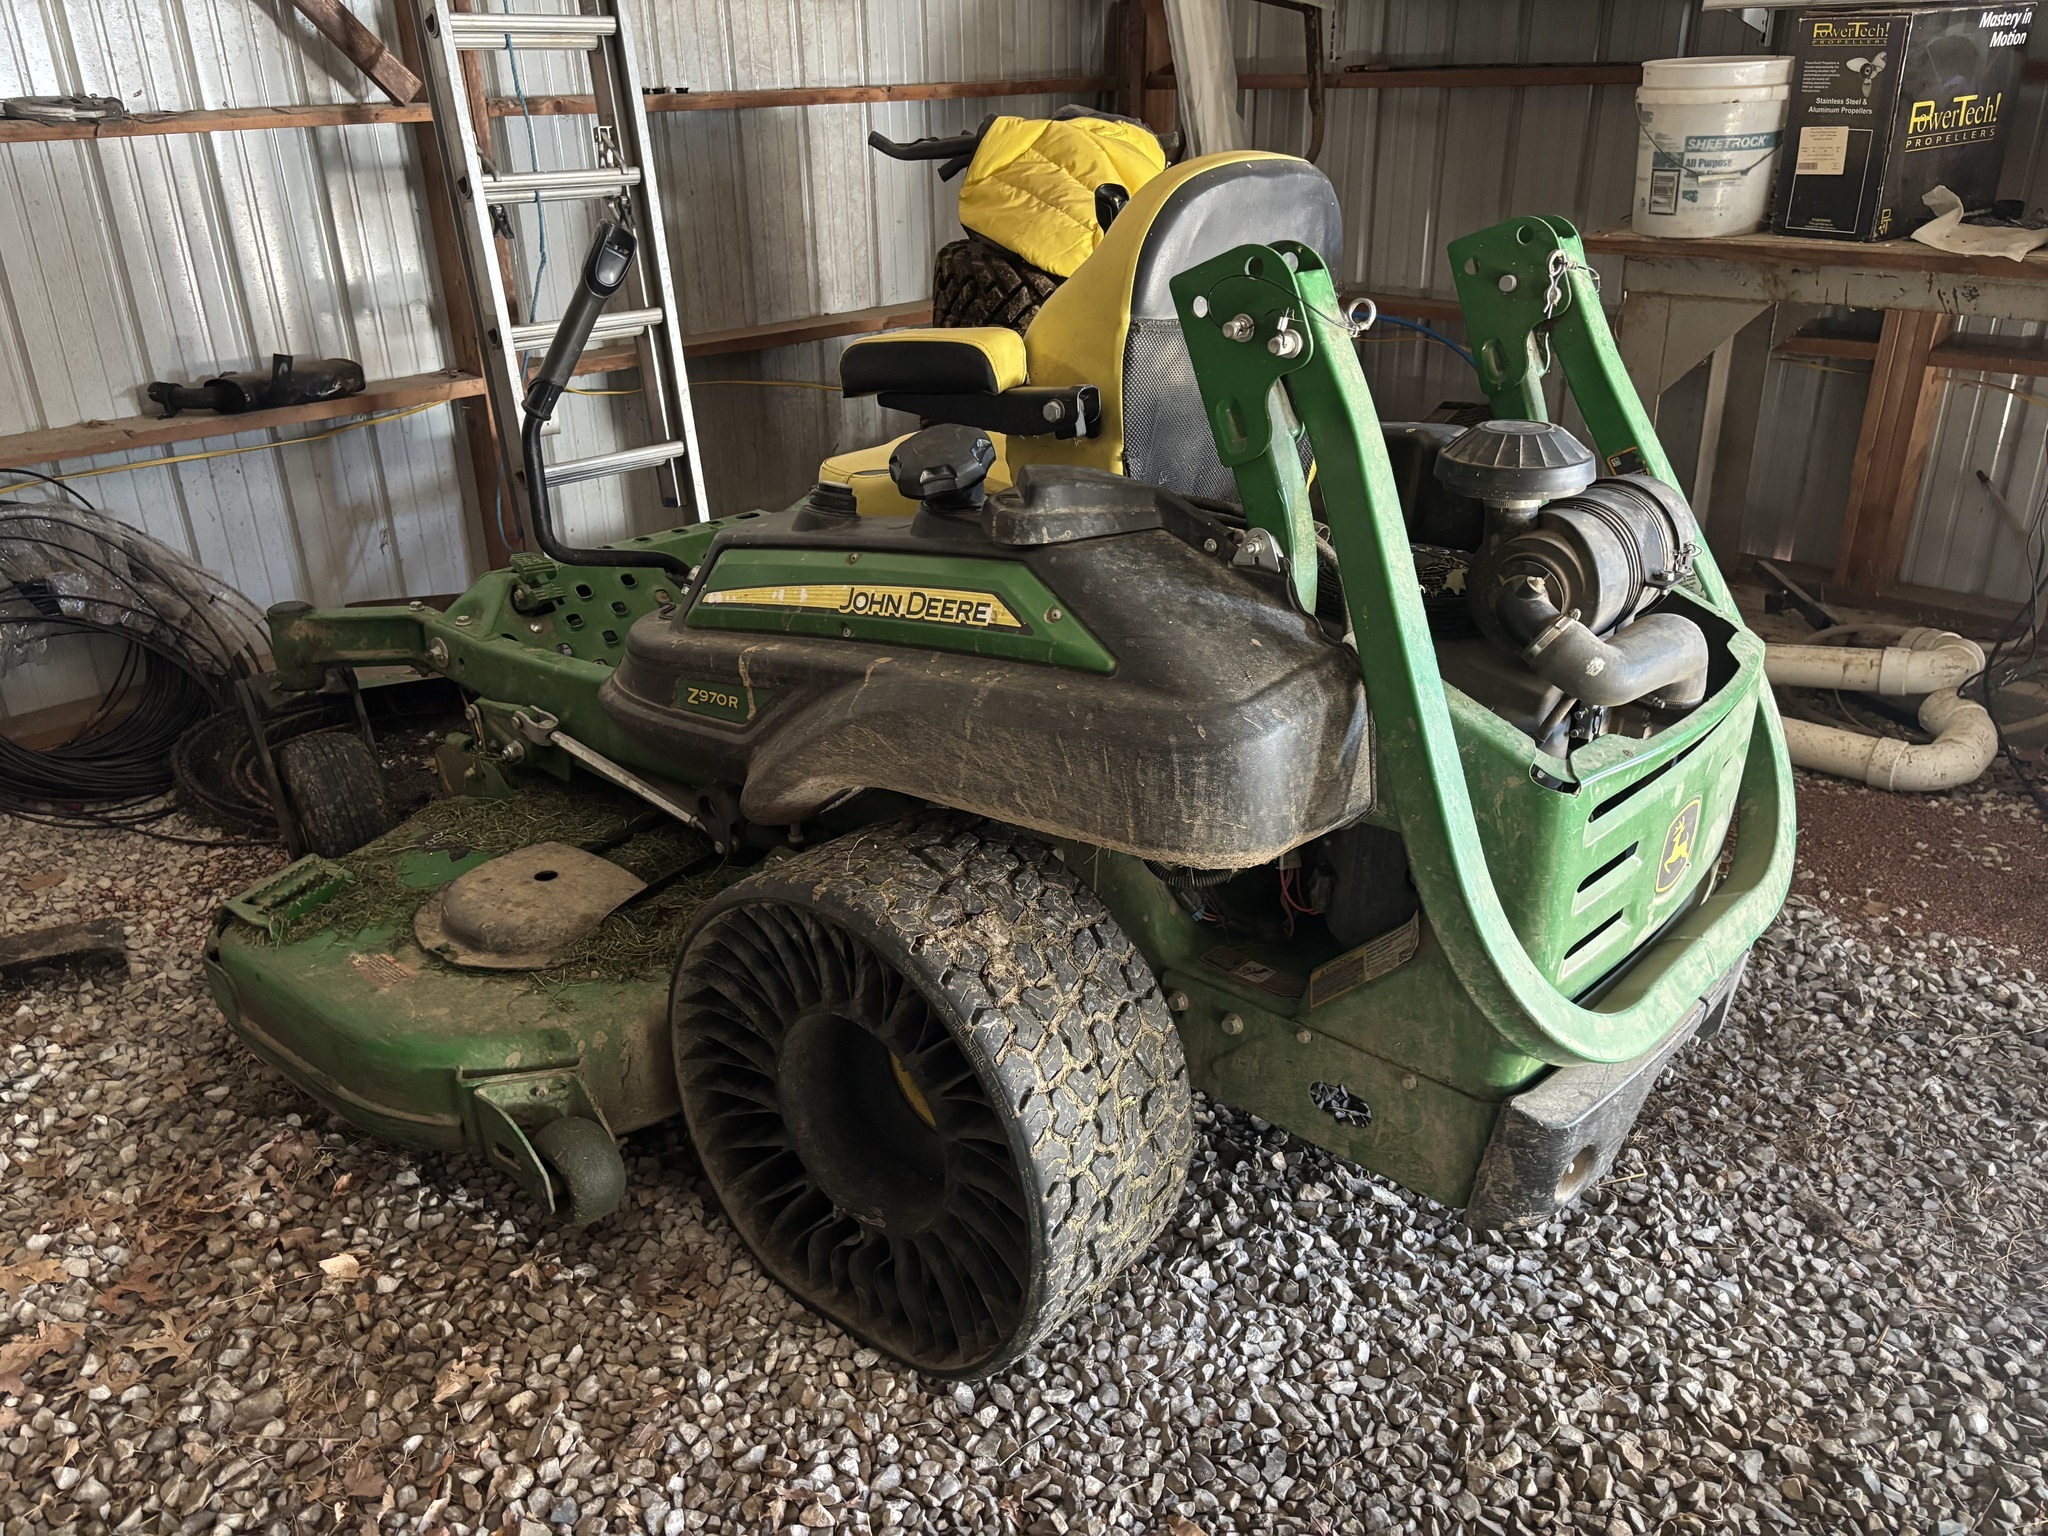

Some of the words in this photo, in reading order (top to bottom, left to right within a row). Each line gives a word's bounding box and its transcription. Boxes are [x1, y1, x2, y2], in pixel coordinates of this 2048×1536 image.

[1979, 11, 2021, 29] Mastery
[2021, 8, 2033, 24] in
[1813, 22, 1890, 38] PowerTech!
[1989, 29, 2028, 48] Motion
[1815, 97, 1844, 105] Stainless
[1840, 106, 1873, 115] Propellers
[1908, 92, 2002, 134] PowerTech!
[1686, 135, 1766, 151] SHEETROCK
[1905, 128, 1996, 149] PROPELLERS
[1684, 158, 1696, 168] All
[1698, 158, 1733, 169] Purpose
[839, 587, 903, 615] JOHN
[905, 591, 991, 623] DEERE
[687, 687, 739, 709] Z970R
